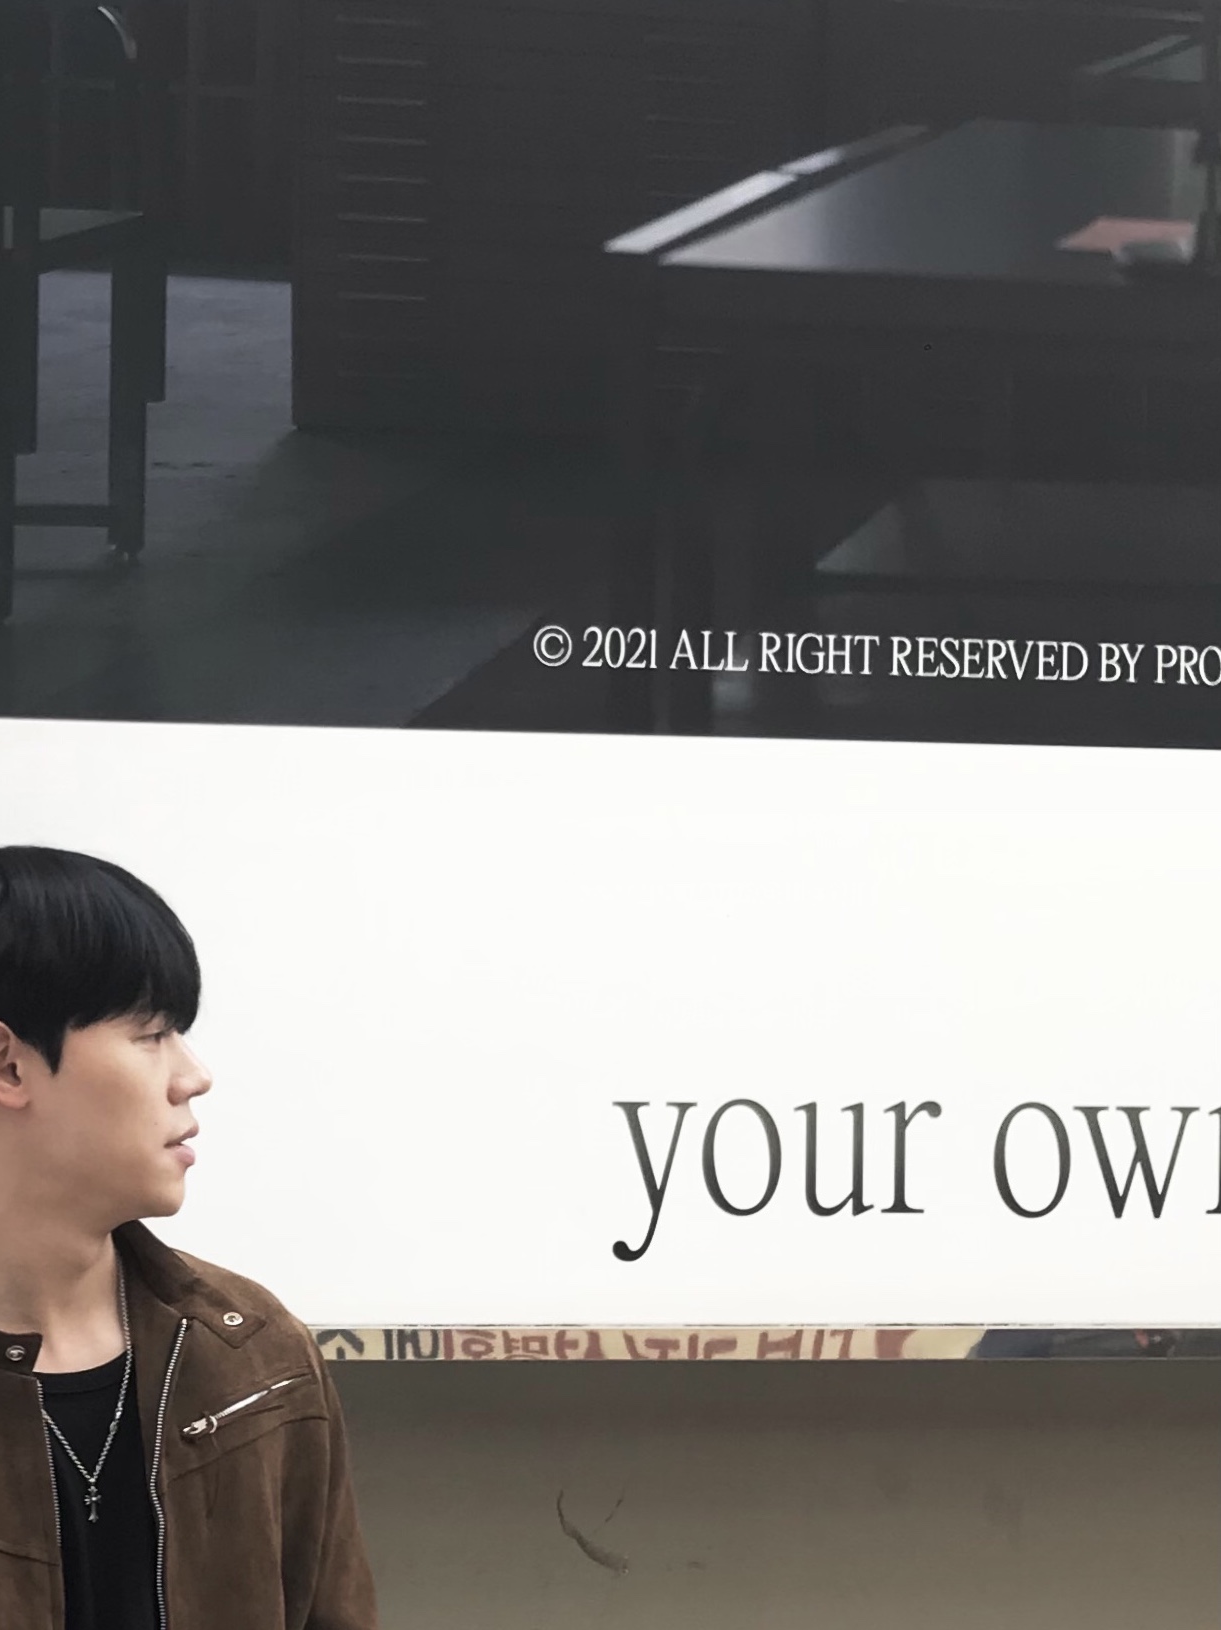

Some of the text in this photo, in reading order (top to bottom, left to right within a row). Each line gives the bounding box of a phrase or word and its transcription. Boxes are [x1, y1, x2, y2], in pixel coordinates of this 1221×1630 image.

[581, 626, 658, 669] 2021
[669, 629, 750, 672] ALL
[758, 631, 880, 675] RIGHT
[889, 636, 1089, 681] RESERVED
[1098, 642, 1145, 684] BY
[1153, 644, 1221, 687] PRO
[612, 1098, 1221, 1262] your ow
